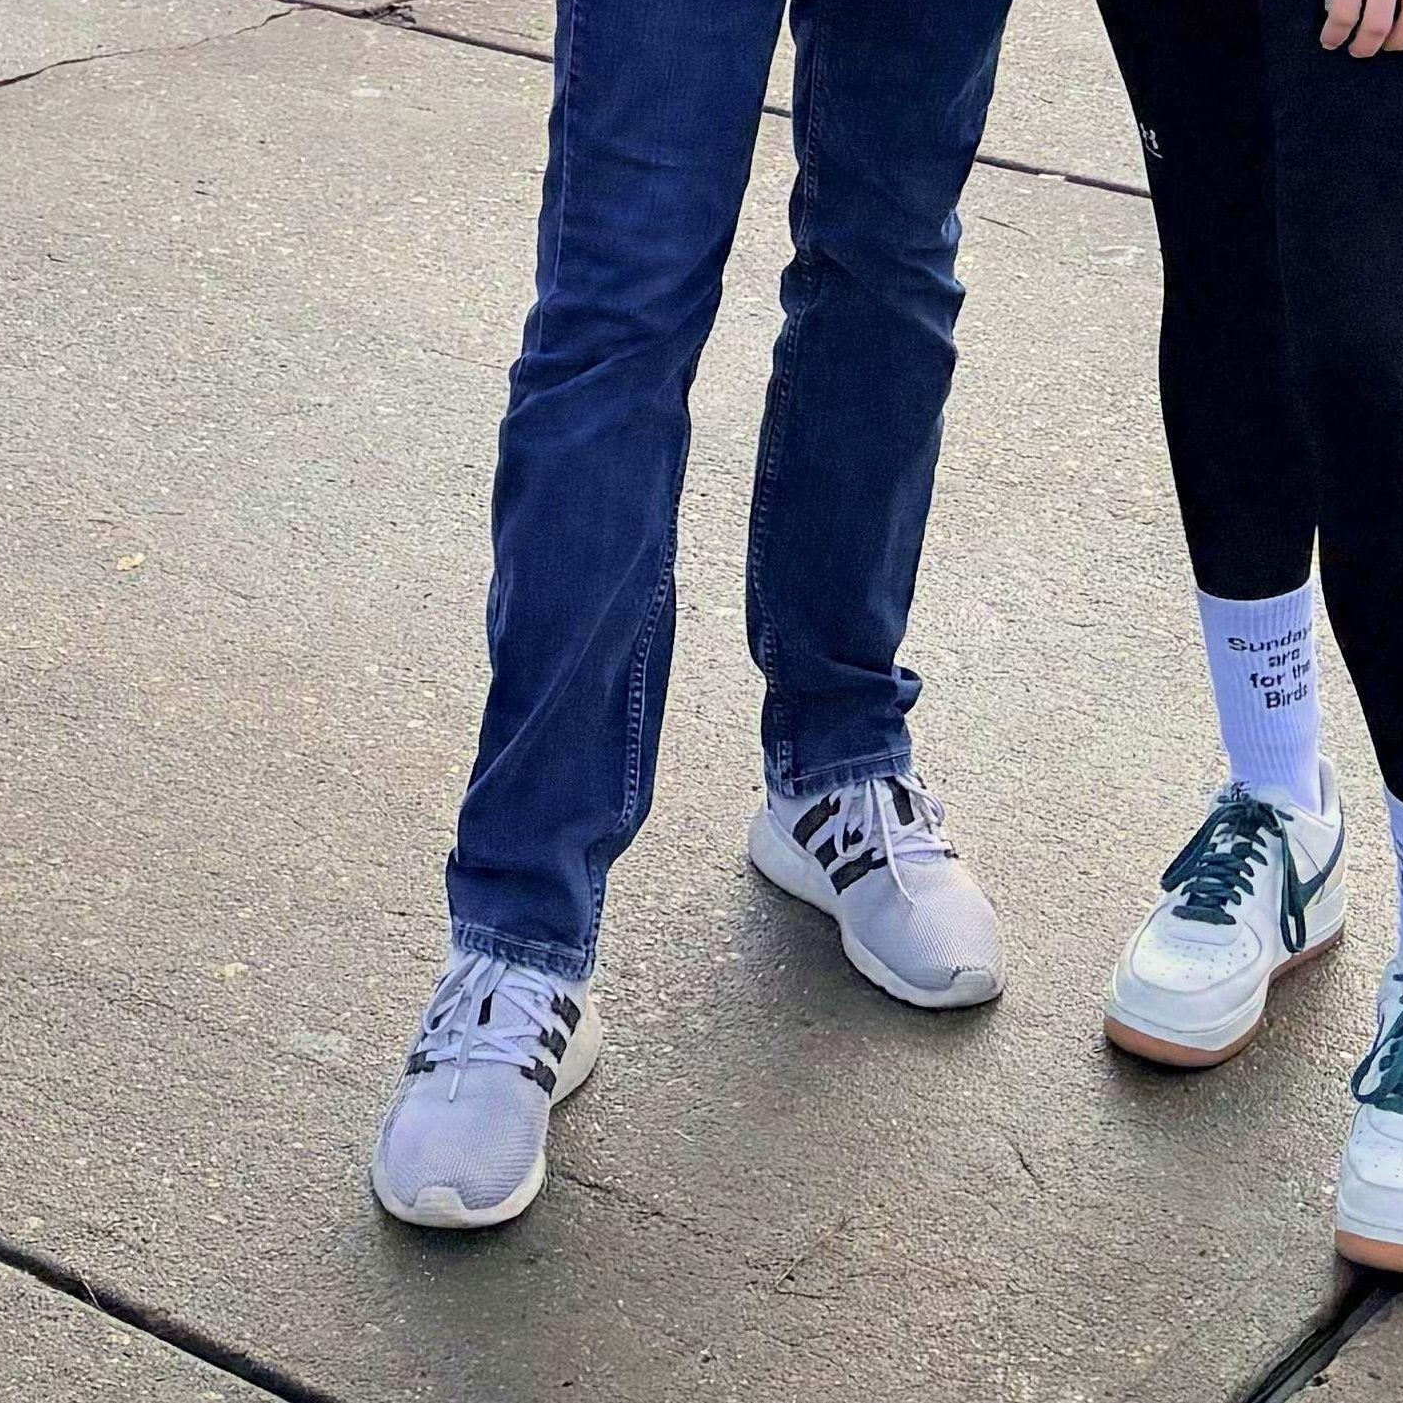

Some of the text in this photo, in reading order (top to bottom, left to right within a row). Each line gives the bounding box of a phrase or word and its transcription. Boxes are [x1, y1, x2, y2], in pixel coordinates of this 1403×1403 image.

[1227, 619, 1313, 653] Sunday
[1268, 647, 1301, 668] are
[1249, 672, 1286, 689] for
[1264, 680, 1308, 710] Birds
